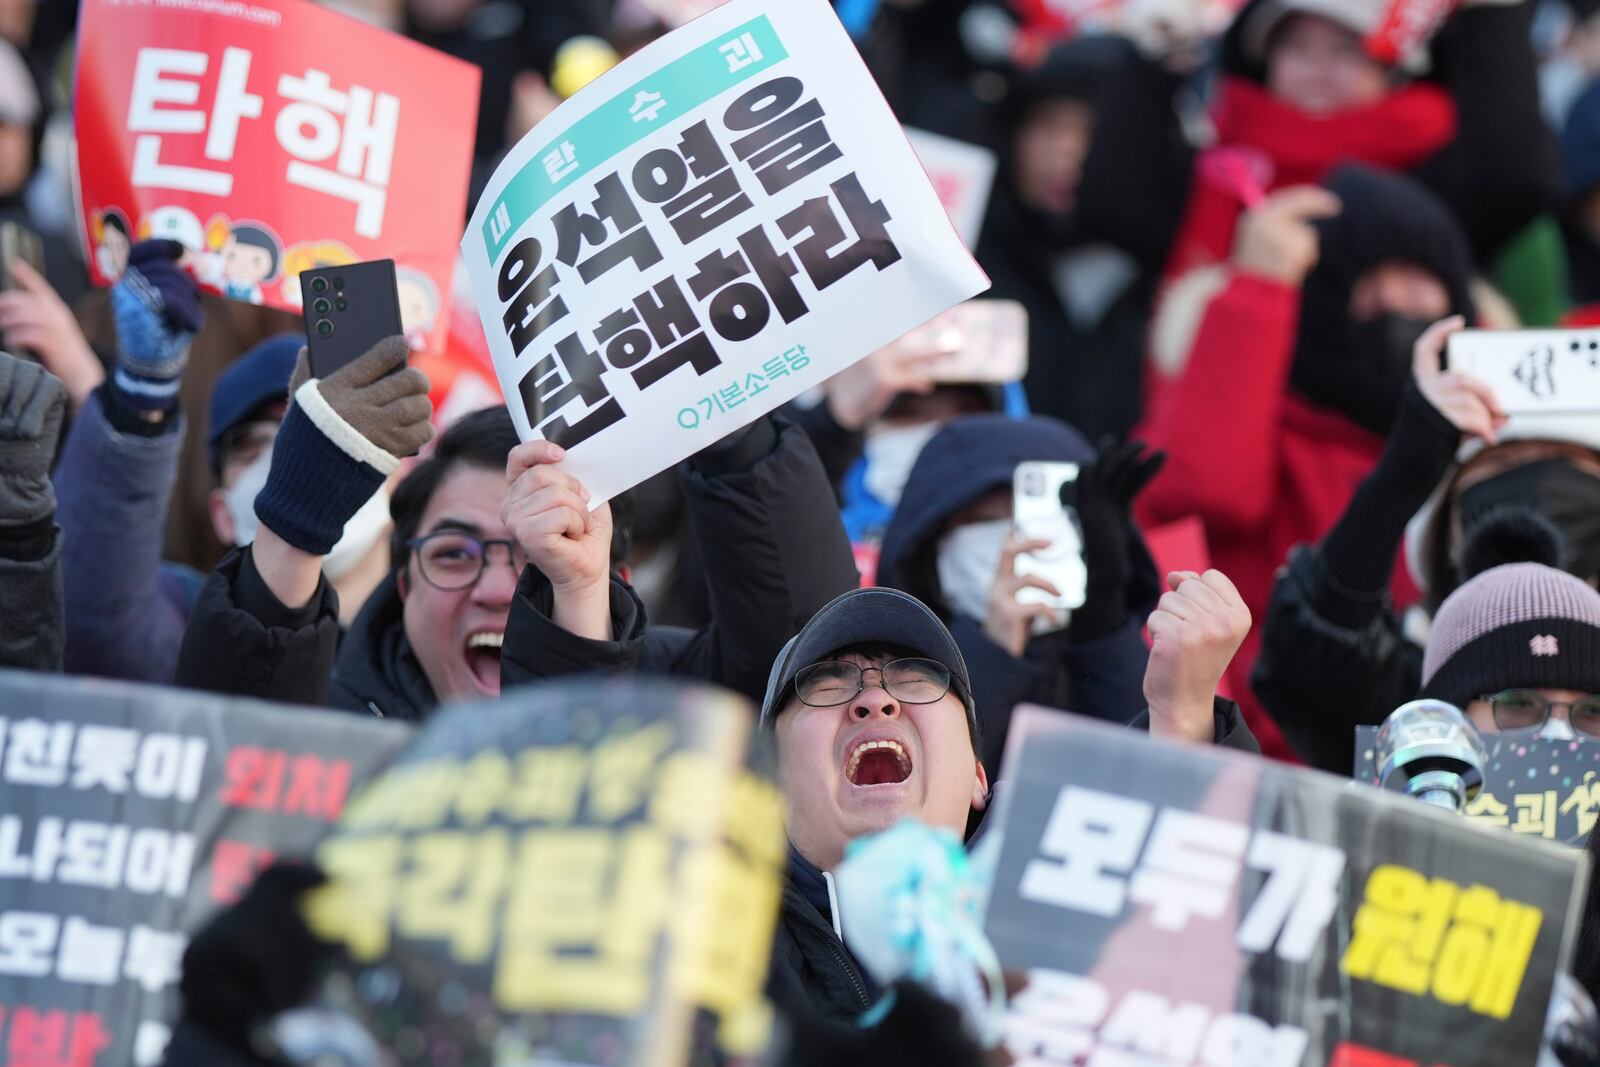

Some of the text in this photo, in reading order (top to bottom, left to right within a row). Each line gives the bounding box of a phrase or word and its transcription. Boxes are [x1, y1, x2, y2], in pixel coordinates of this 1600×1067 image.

[128, 46, 400, 239] 탄핵
[489, 31, 764, 246] 내란수괴
[497, 76, 844, 358] 윤석열을
[518, 171, 903, 450] 탄핵하라
[697, 343, 811, 420] 기본소득당
[0, 714, 208, 802] 친듯이
[1019, 784, 1544, 1020] 모두가 원해
